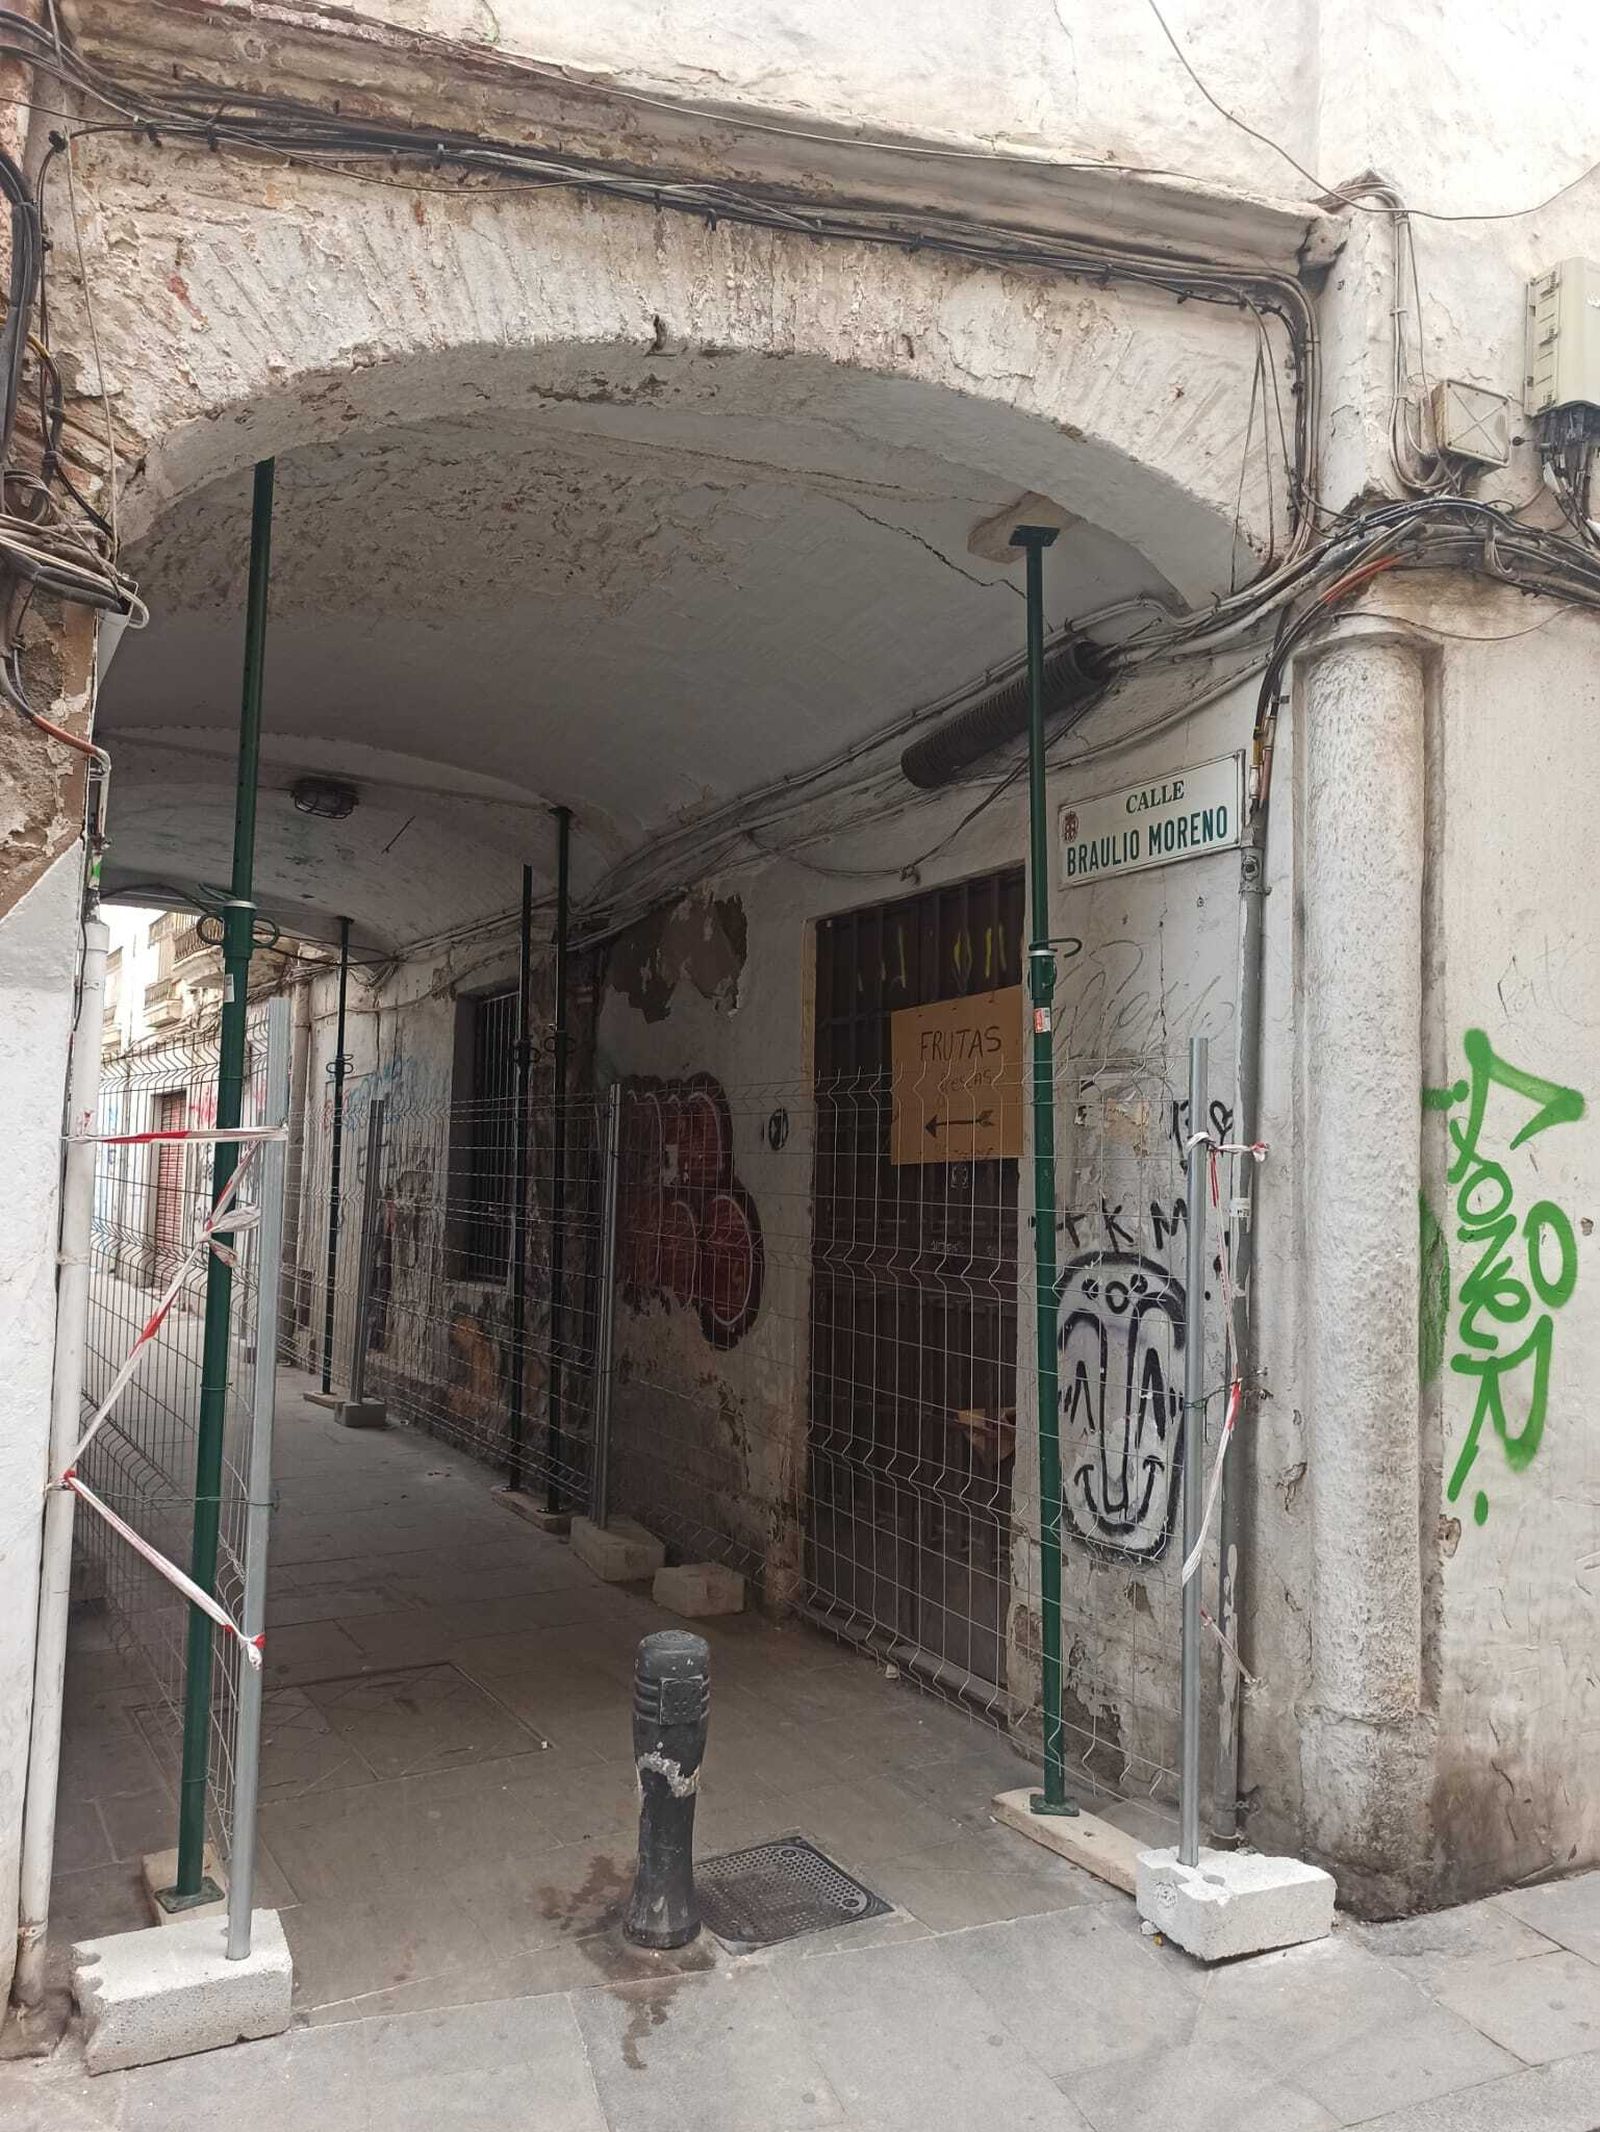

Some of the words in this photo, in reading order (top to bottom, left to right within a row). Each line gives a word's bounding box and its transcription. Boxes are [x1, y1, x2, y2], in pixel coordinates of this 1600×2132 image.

[1126, 780, 1184, 814] CALLE
[1067, 829, 1140, 876] BRAULIO
[1149, 805, 1228, 856] MORENO
[920, 1026, 1002, 1061] FRUTAS
